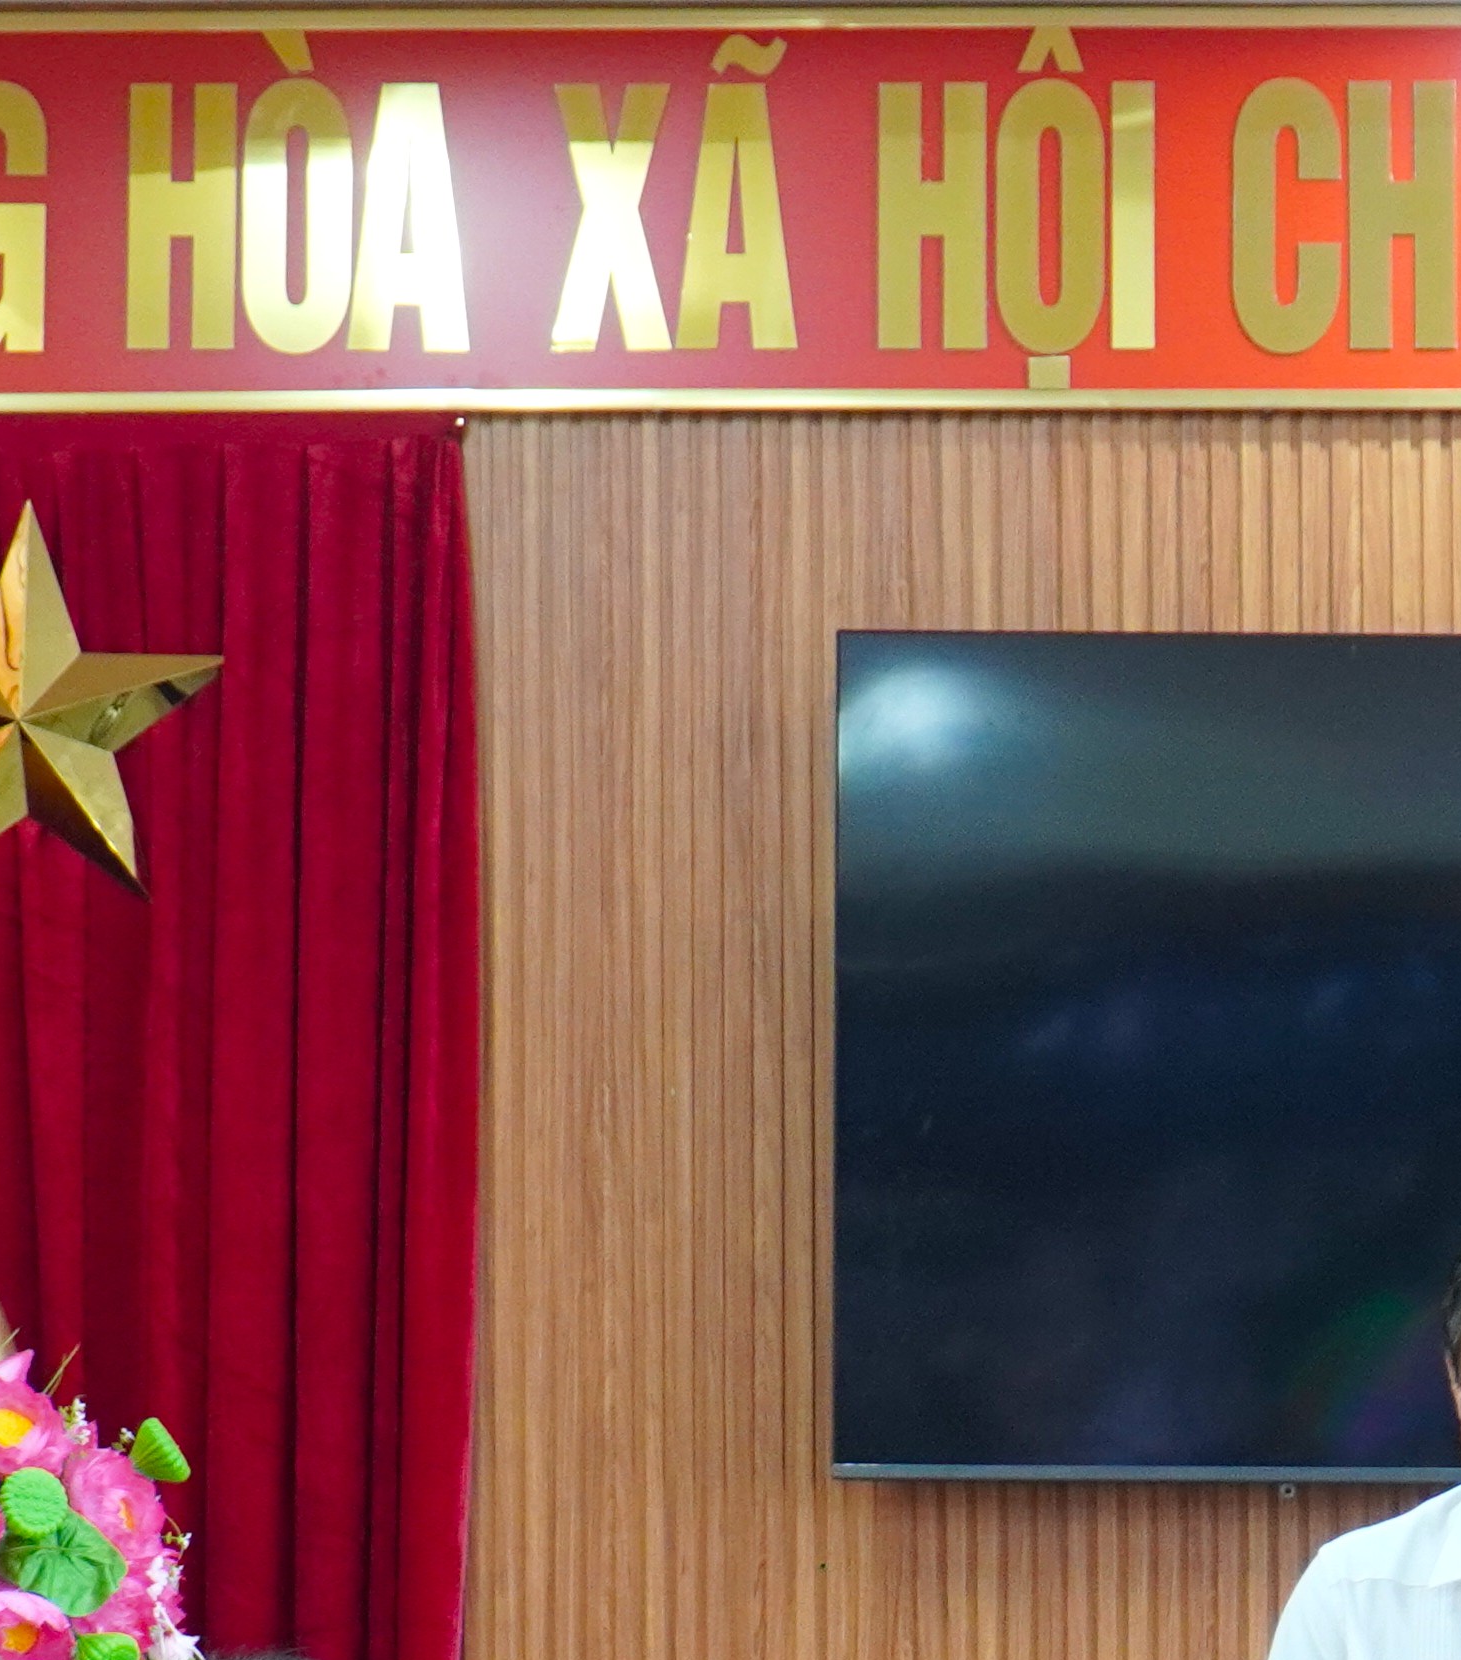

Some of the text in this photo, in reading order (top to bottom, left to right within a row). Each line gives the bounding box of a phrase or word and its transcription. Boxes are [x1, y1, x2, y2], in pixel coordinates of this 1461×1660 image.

[127, 28, 471, 355] HÒA
[551, 38, 801, 352] XÃ
[877, 25, 1157, 390] HỘI
